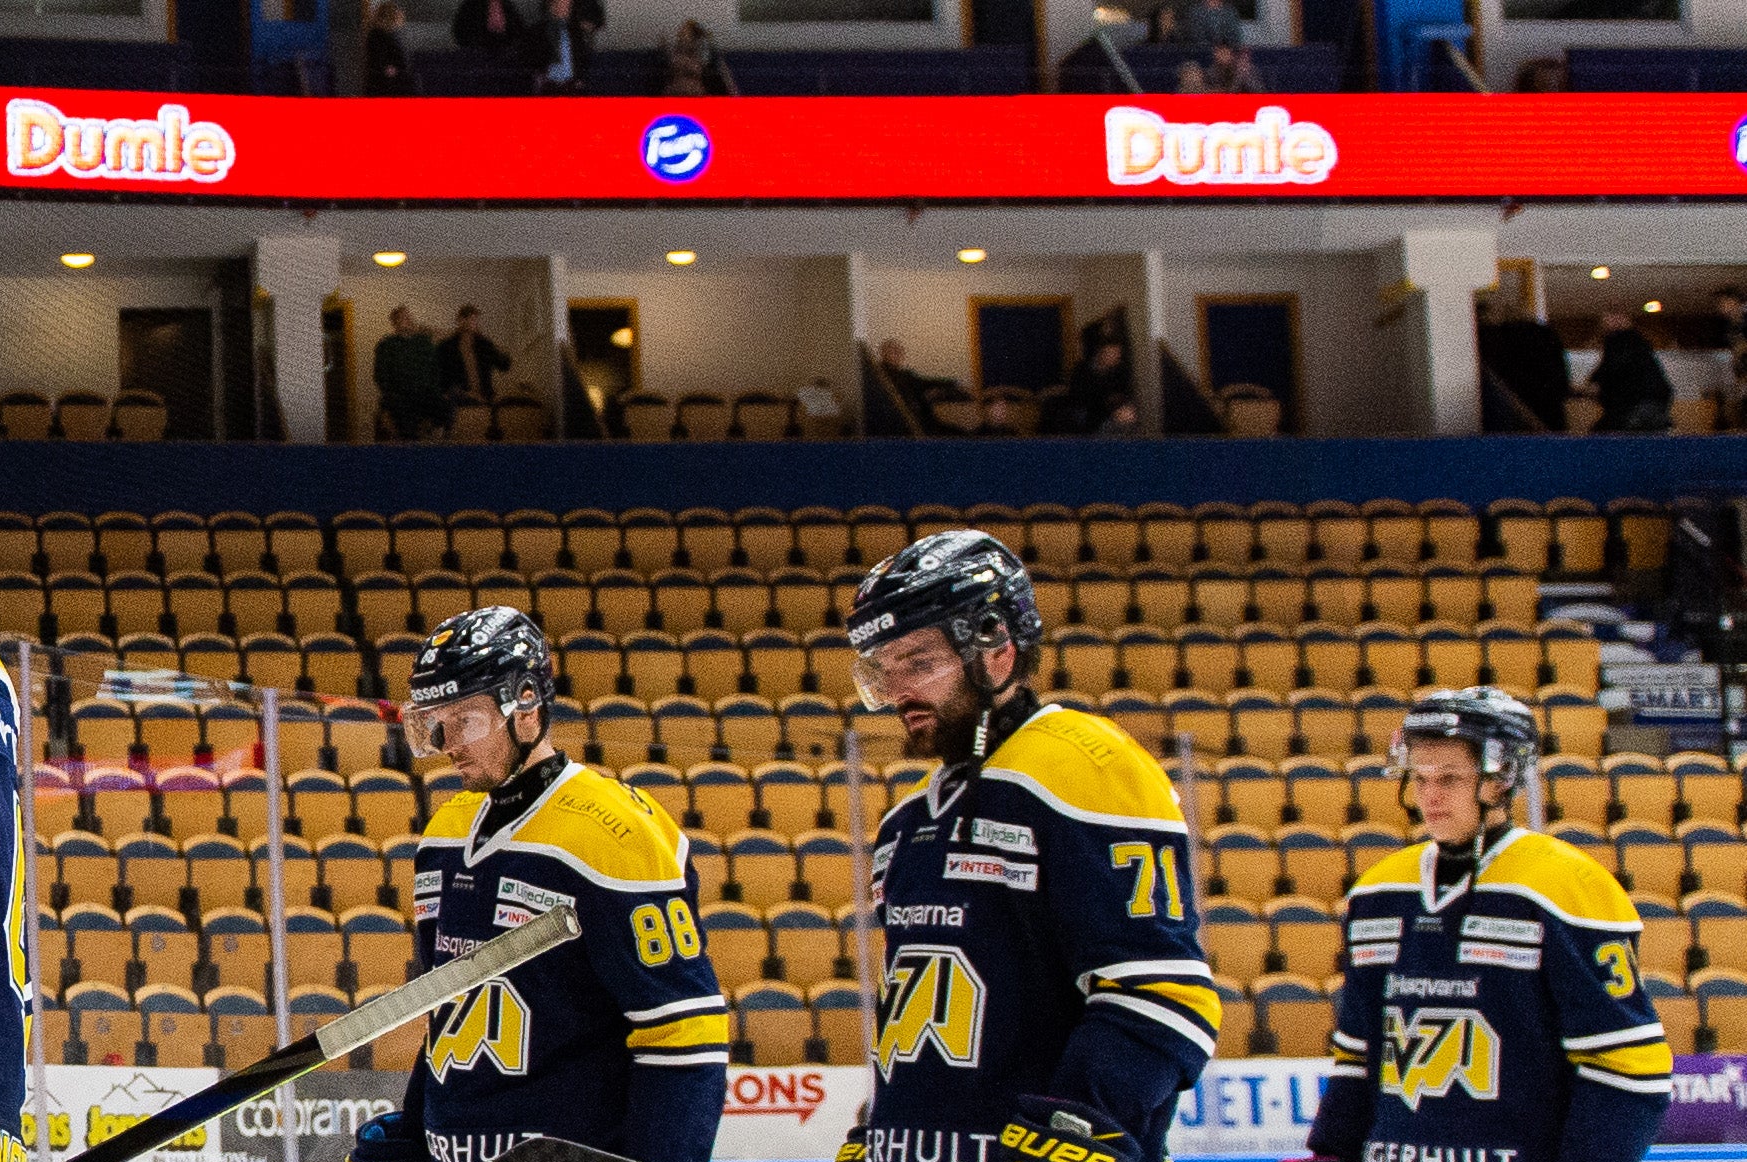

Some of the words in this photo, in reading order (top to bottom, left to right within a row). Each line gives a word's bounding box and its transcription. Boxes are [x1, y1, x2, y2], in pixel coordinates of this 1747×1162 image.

[8, 100, 234, 182] Dumle
[1109, 106, 1335, 184] Dumle
[1110, 842, 1185, 921] 71
[630, 898, 702, 968] 88
[1595, 937, 1645, 999] 3
[727, 1073, 826, 1106] ONS
